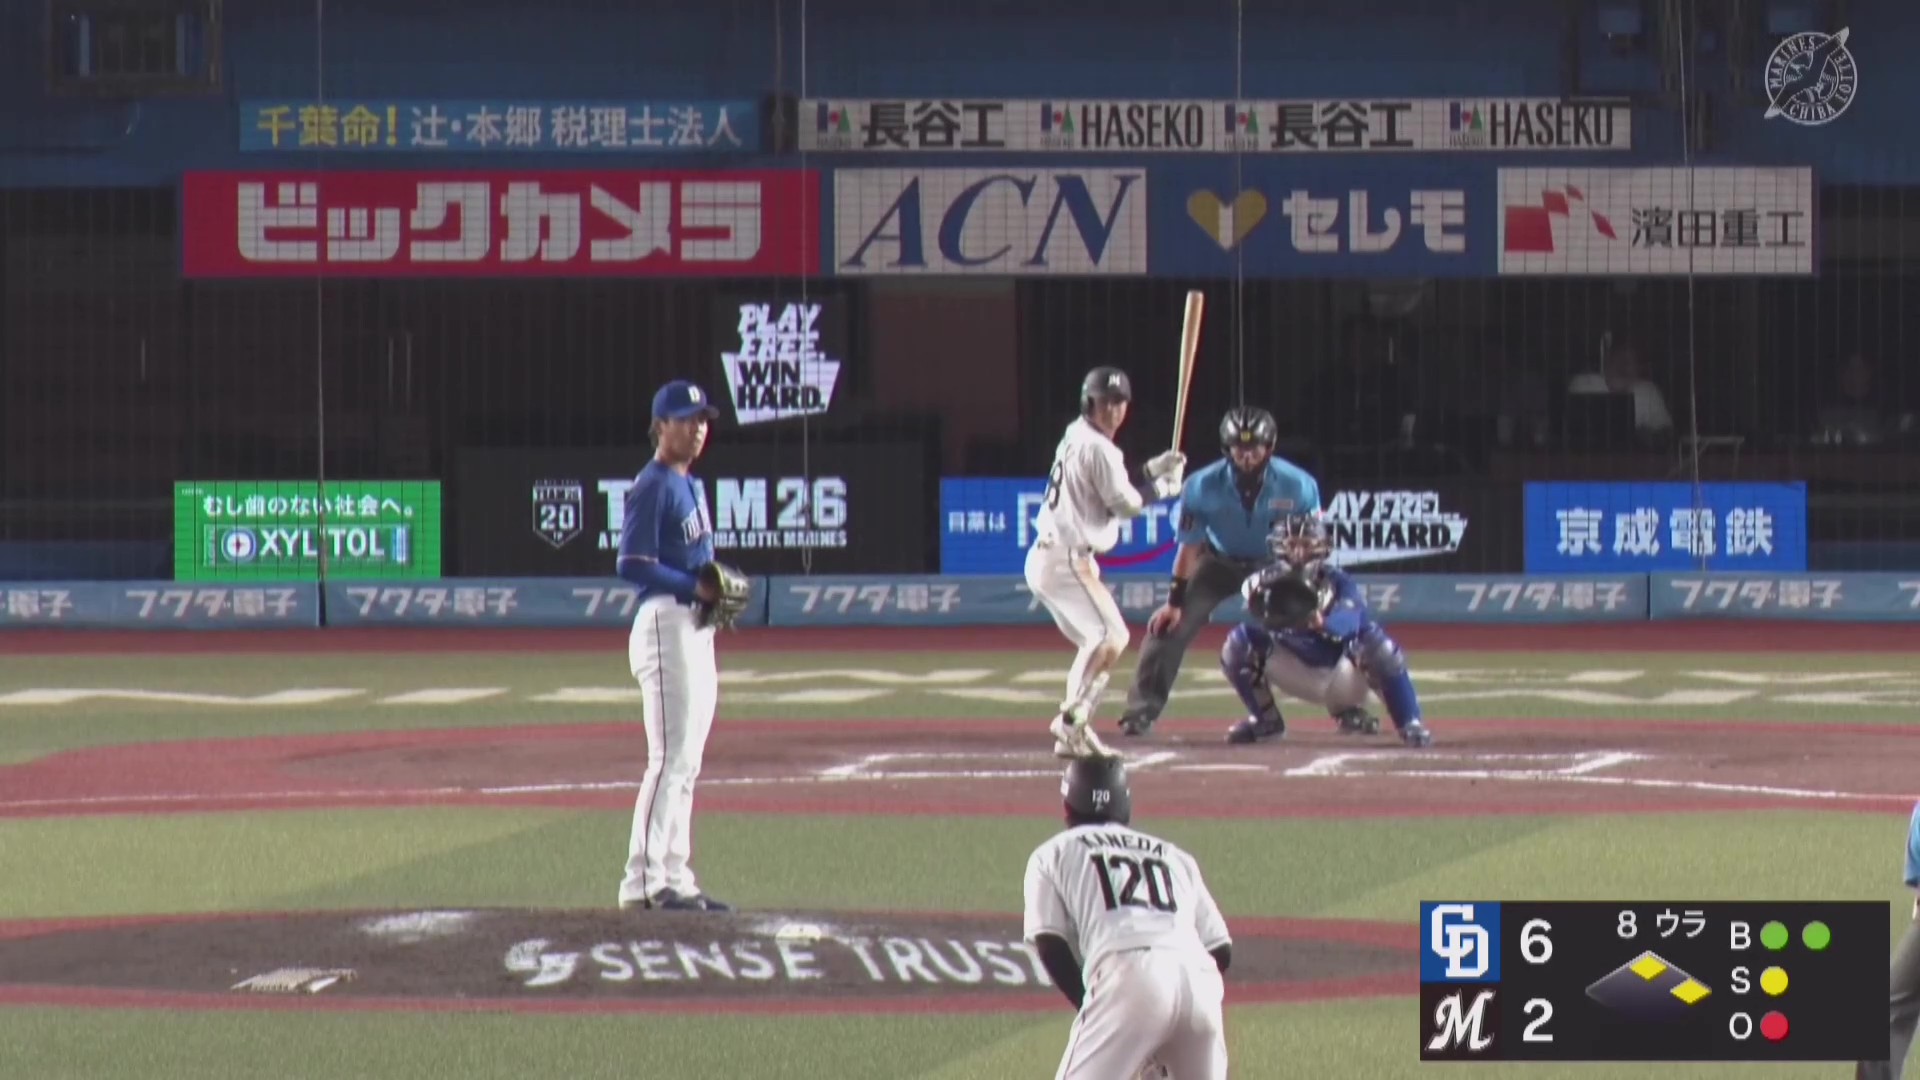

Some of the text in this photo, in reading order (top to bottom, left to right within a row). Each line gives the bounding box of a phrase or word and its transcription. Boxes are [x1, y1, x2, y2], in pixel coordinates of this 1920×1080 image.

[862, 102, 1005, 148] 長谷工
[1081, 104, 1205, 148] HASEKO
[1269, 102, 1413, 149] 長谷工
[238, 181, 761, 261] ビックカメラ
[840, 174, 1142, 268] ACN
[1282, 189, 1466, 253] セレモ
[1632, 206, 1805, 248] 濱田重工
[738, 303, 822, 333] PLAY
[738, 361, 801, 385] WIN
[737, 386, 826, 410] HARD.
[540, 504, 575, 530] 20
[598, 478, 768, 530] TM
[776, 478, 847, 529] 26
[948, 511, 1005, 533] 目薬は
[1362, 523, 1457, 549] HARD.
[1556, 507, 1773, 556] 京成電鉄
[784, 531, 847, 548] MARINES
[126, 588, 297, 618] フクダ電子
[346, 587, 517, 617] フクダ電子
[789, 583, 961, 614] フクダ電子
[1455, 582, 1627, 612] フクダ電子
[1670, 579, 1842, 609] フクダ電子
[1092, 789, 1111, 803] 120
[1077, 834, 1163, 857] KANEDA
[1090, 853, 1178, 913] 120
[592, 935, 1053, 987] SENSE TRUST
